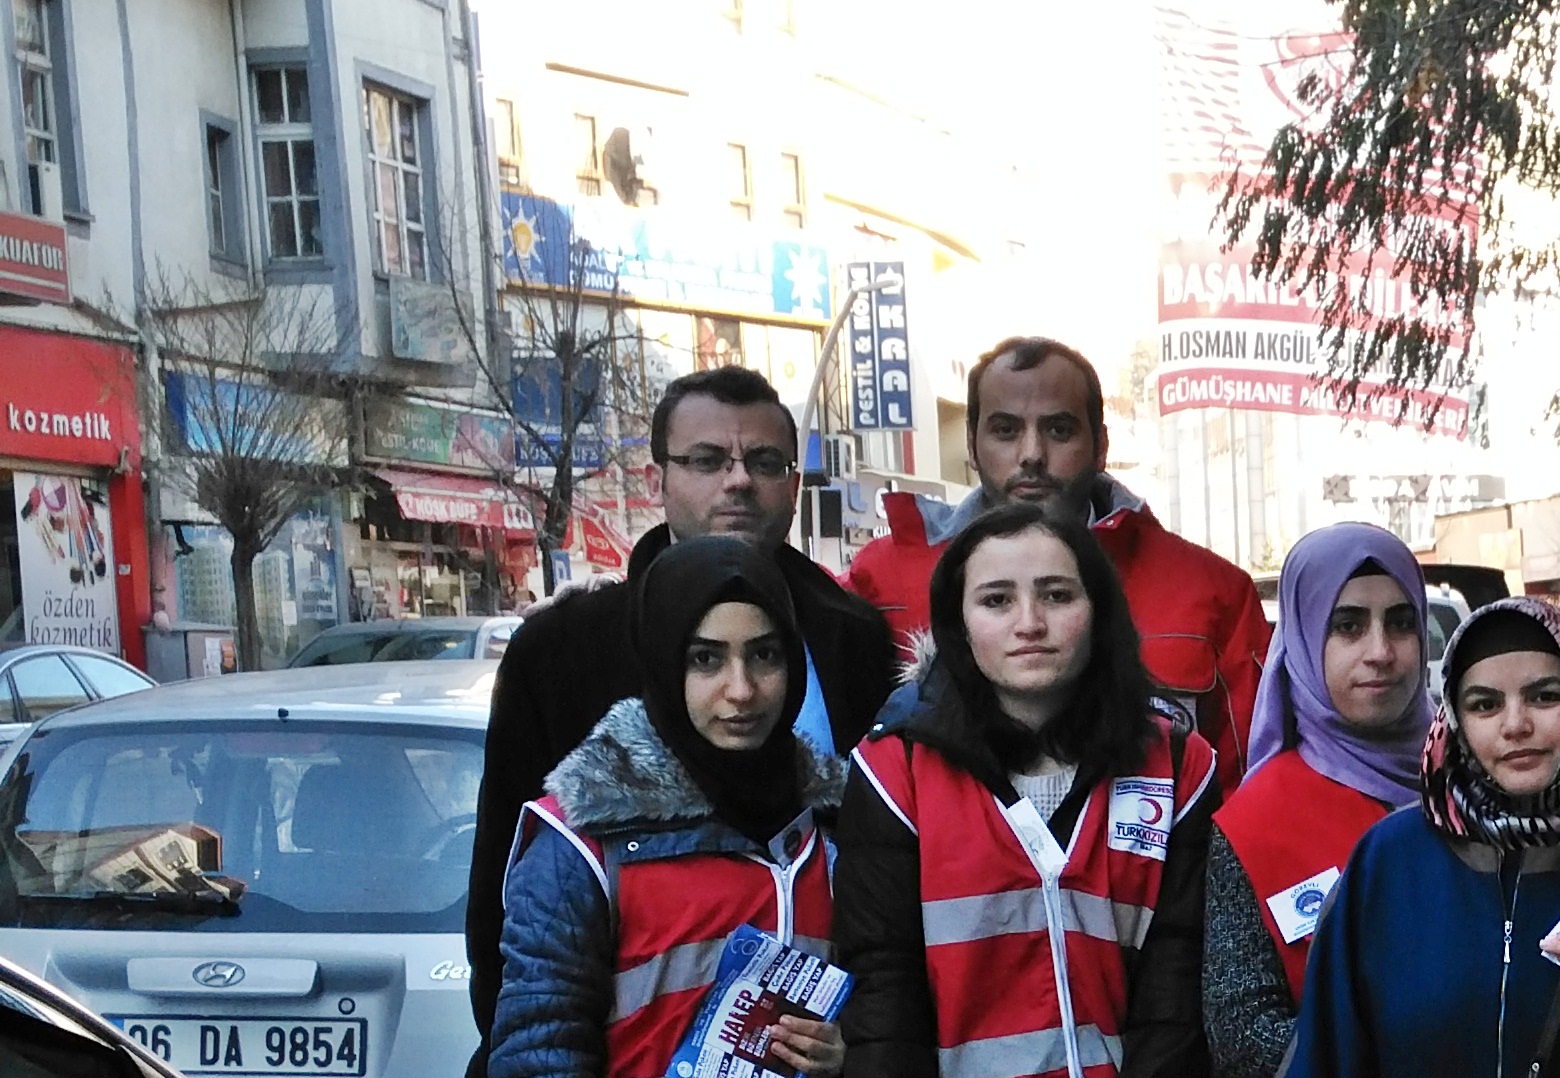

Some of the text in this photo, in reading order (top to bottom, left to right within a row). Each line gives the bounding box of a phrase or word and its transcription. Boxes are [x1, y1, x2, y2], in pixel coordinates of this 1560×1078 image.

[1162, 329, 1248, 363] H.OSMAN
[1254, 329, 1315, 366] AKGÜL
[1162, 373, 1293, 405] GÜMÜŞHANE
[8, 402, 111, 440] kozmetik
[43, 591, 95, 618] özden
[30, 617, 114, 649] kozmetik
[812, 966, 822, 980] YAP
[717, 987, 758, 1045] HALEP
[200, 1024, 243, 1066] DA
[266, 1026, 357, 1068] 9854
